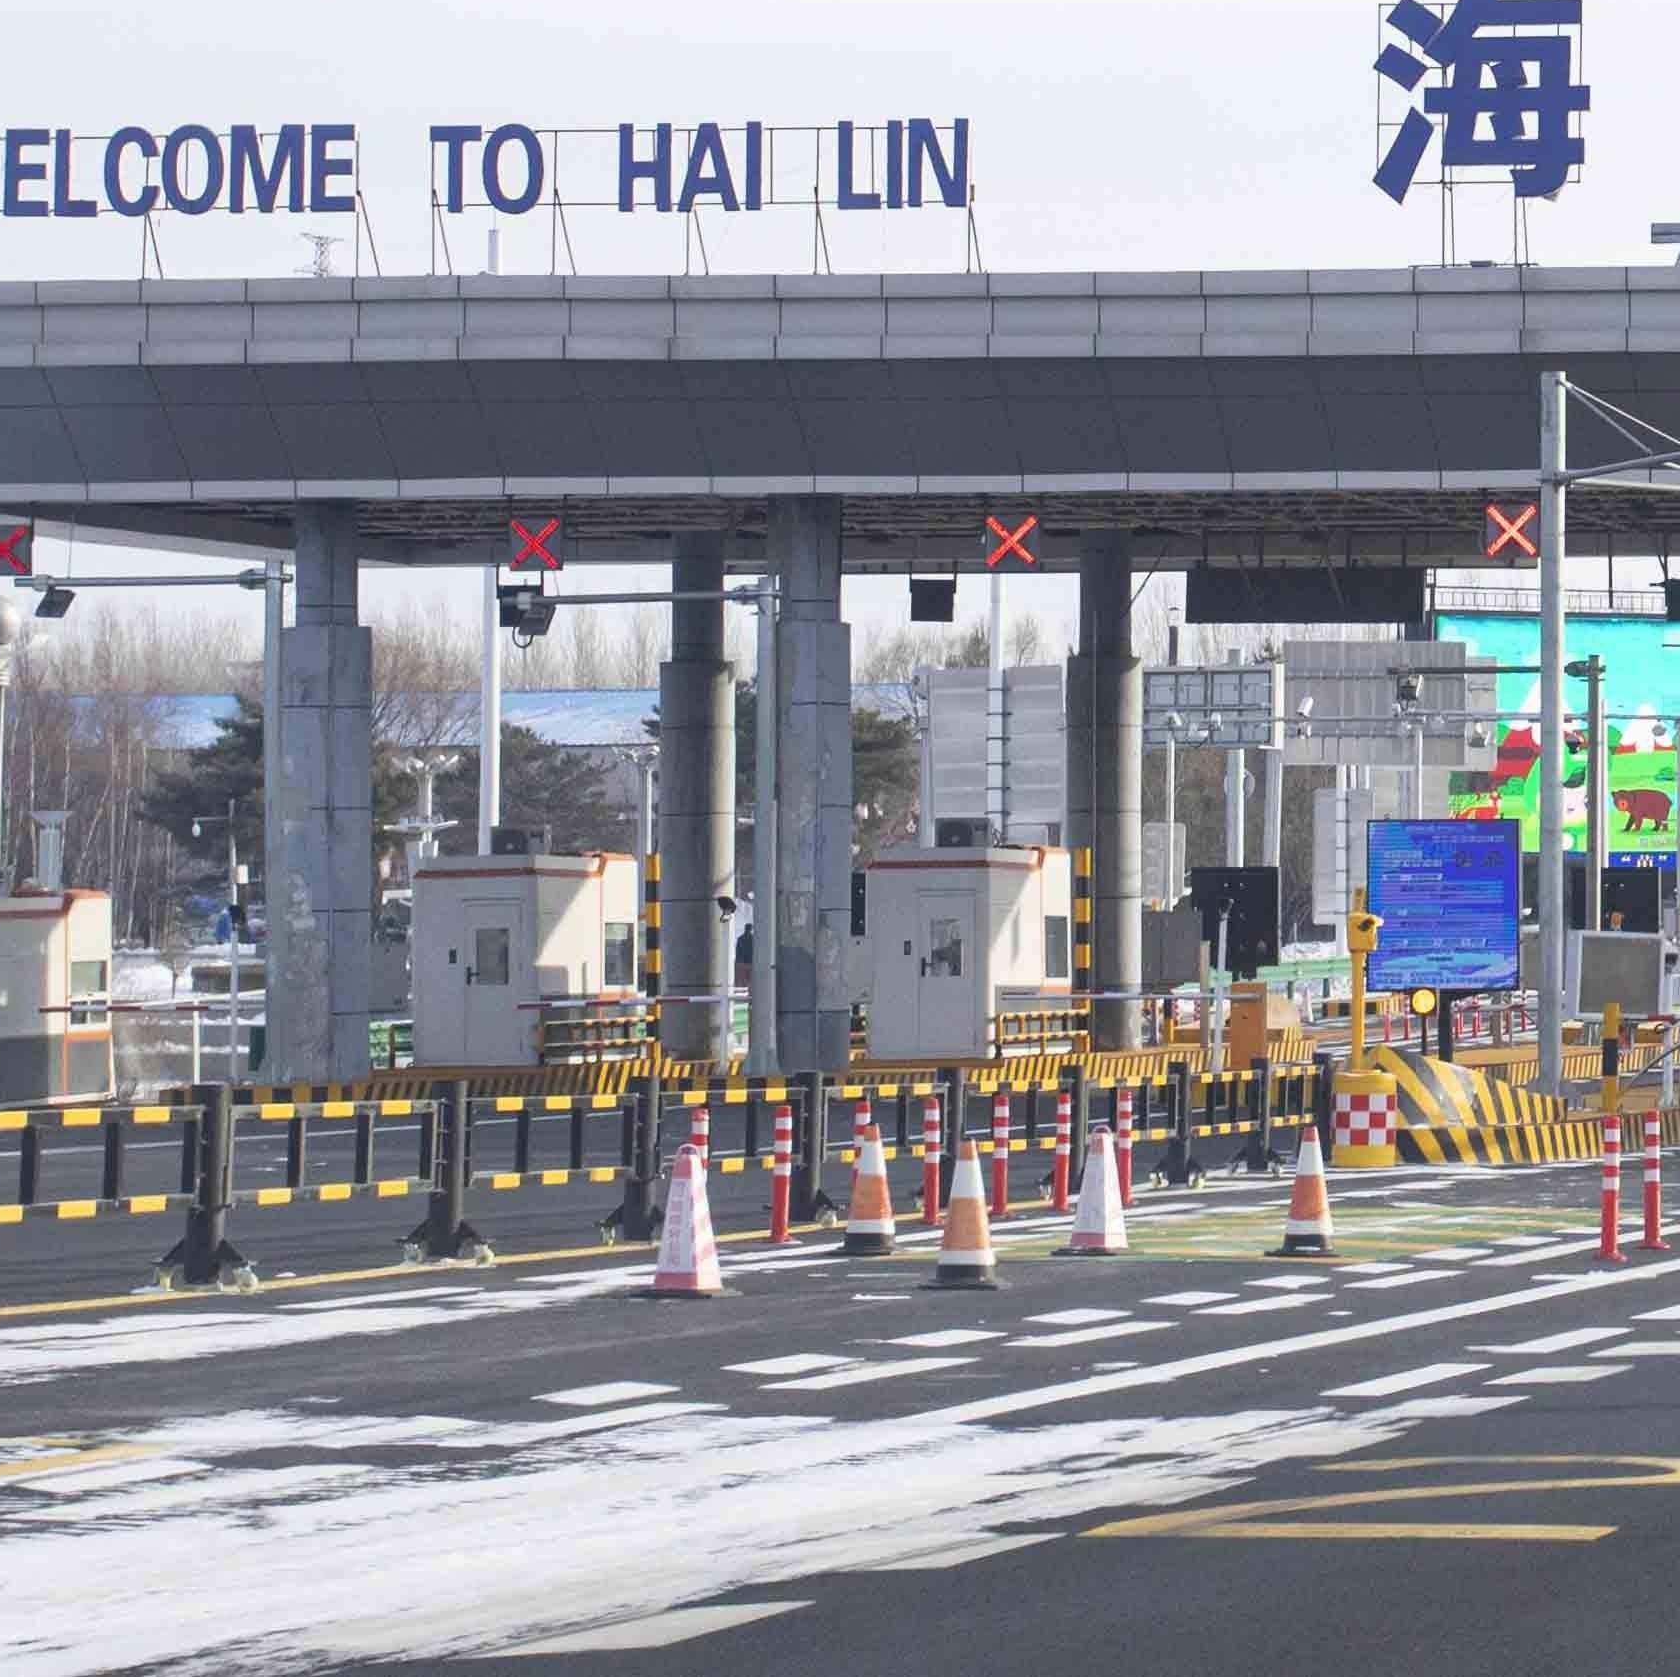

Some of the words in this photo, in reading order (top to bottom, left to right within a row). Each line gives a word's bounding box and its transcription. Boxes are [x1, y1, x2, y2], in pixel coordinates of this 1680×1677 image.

[3, 124, 355, 218] ELCOME
[429, 124, 544, 214] TO
[619, 121, 761, 212] HAI
[837, 117, 969, 210] LIN
